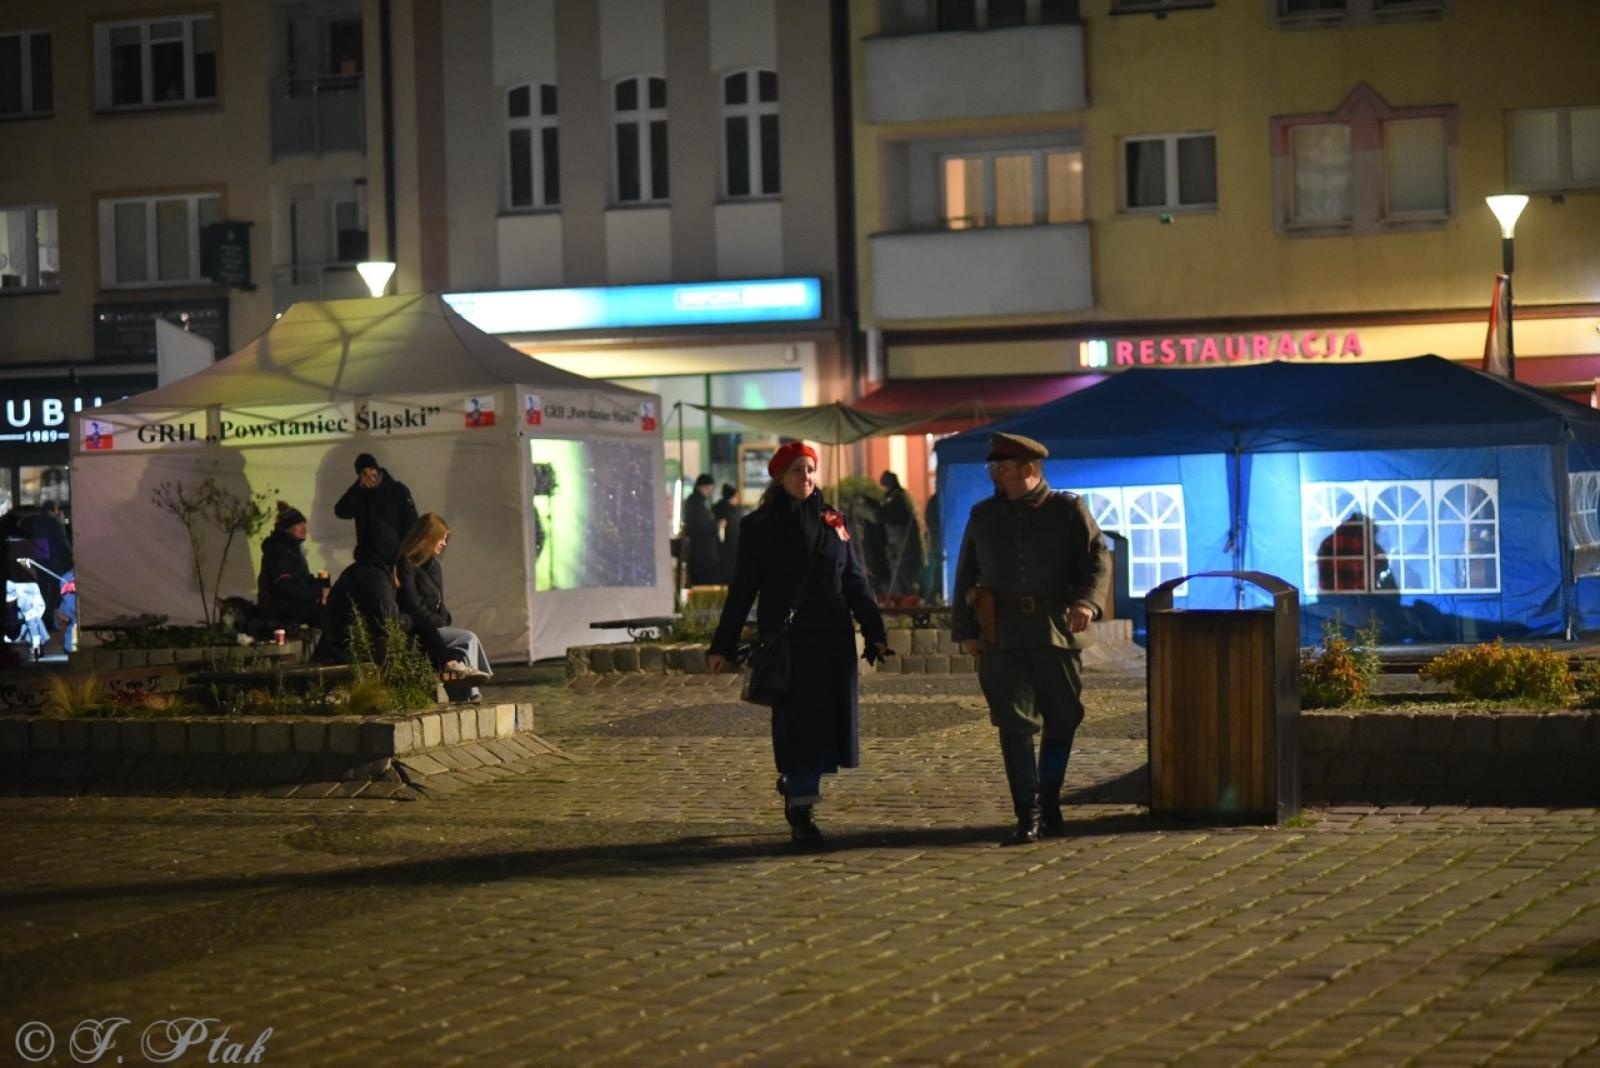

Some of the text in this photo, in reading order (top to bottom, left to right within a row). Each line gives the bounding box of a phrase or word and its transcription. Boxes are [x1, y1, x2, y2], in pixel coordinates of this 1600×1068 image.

[1115, 331, 1363, 366] RESTAURACJA
[137, 404, 440, 443] GRH „Powstaniec Śląski”
